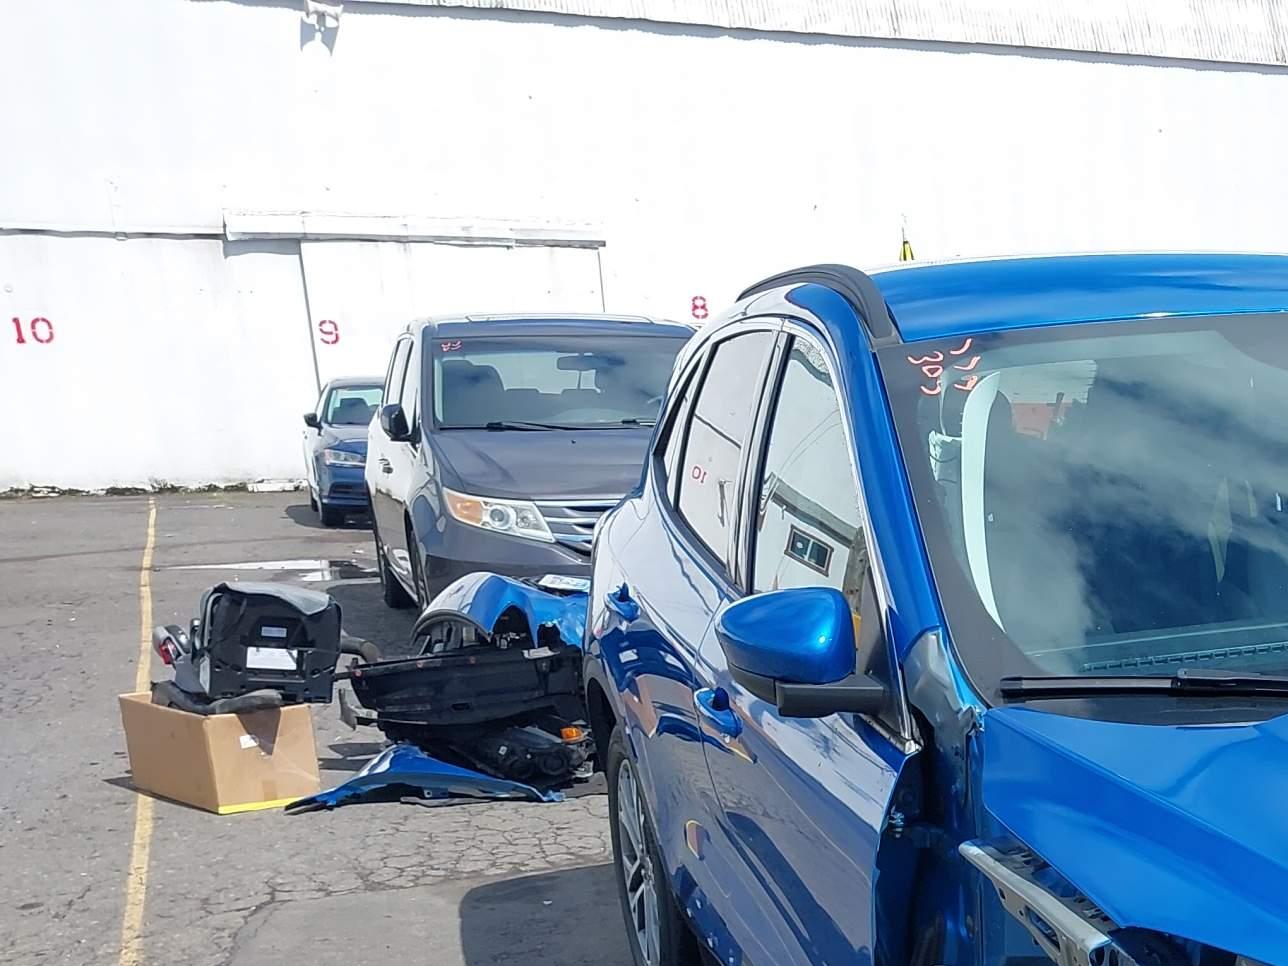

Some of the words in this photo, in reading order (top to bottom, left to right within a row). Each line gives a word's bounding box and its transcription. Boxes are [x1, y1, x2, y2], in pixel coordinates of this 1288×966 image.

[691, 295, 709, 319] 8
[12, 317, 54, 344] 10
[319, 320, 339, 344] 9
